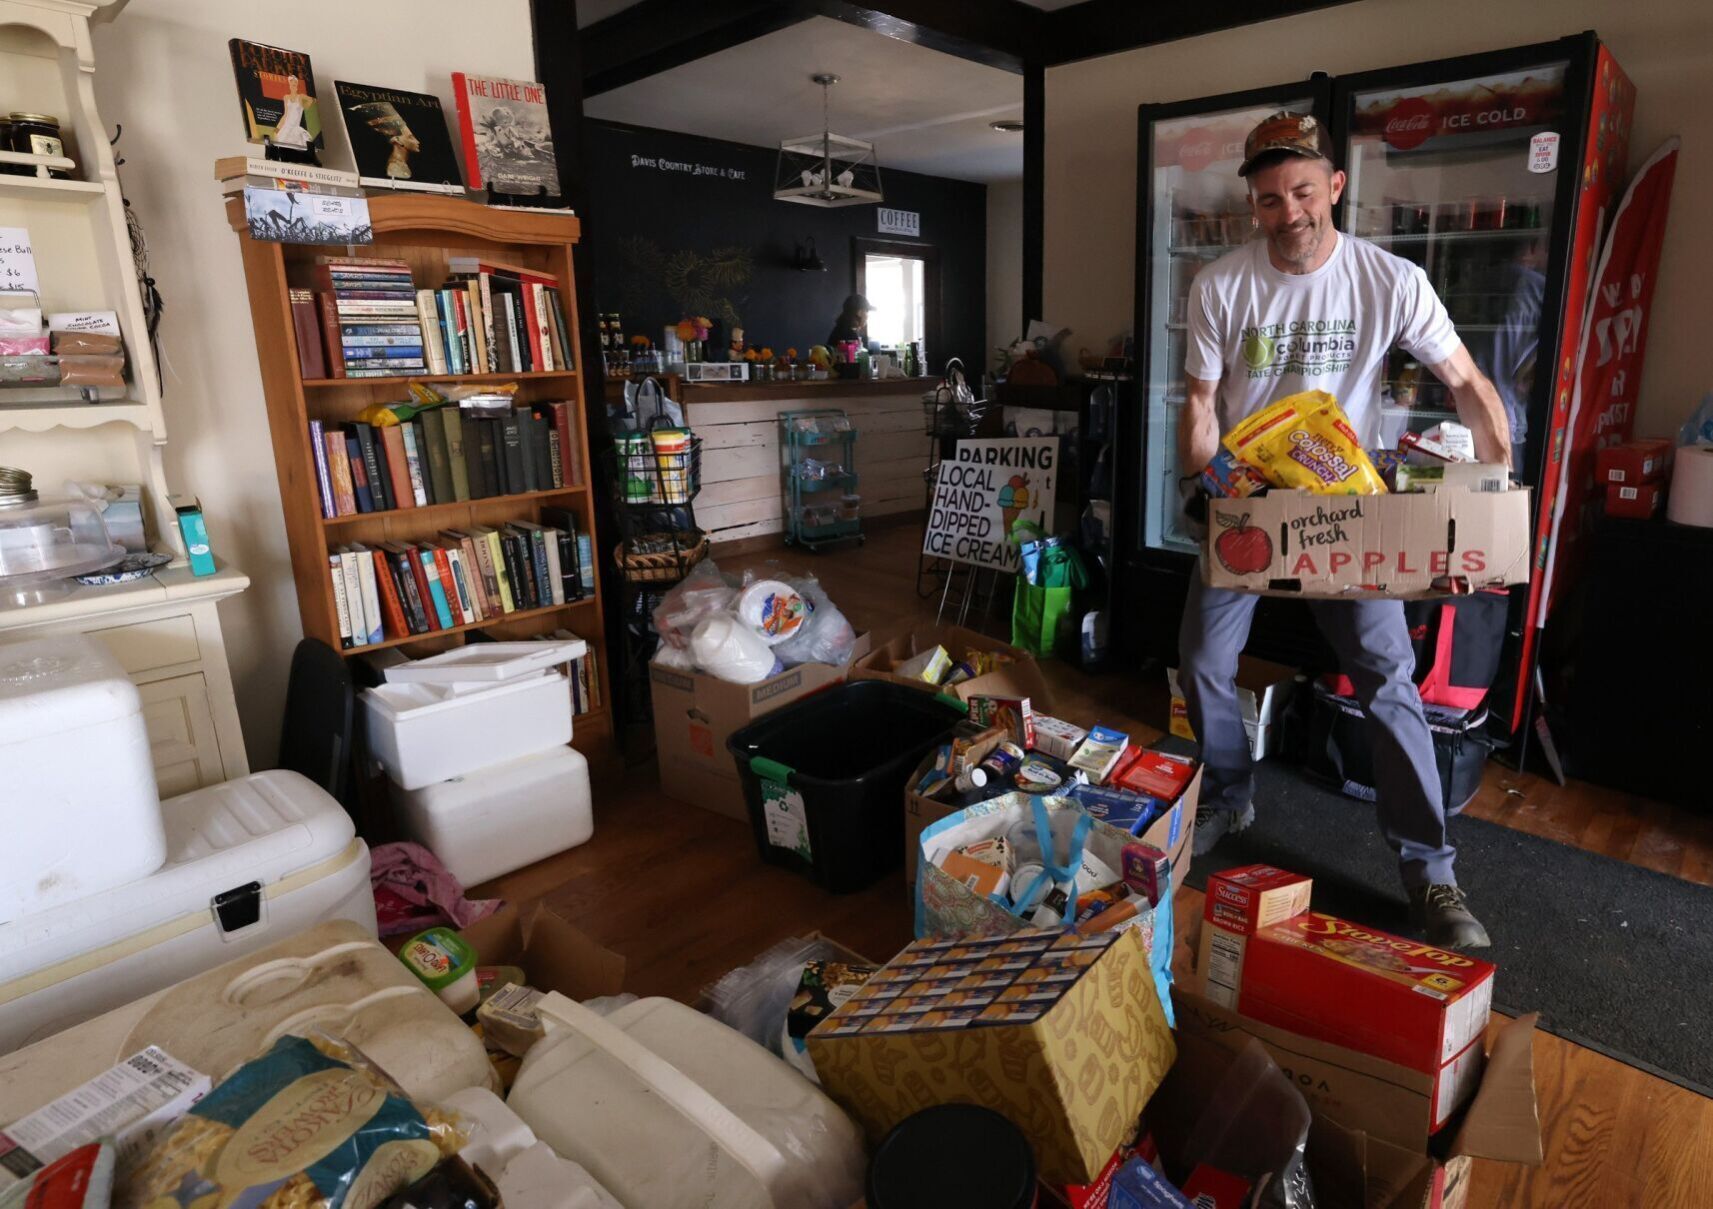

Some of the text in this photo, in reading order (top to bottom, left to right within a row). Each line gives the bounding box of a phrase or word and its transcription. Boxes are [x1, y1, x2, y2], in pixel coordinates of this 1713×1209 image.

[339, 85, 440, 109] Egyptian Art
[468, 78, 545, 105] THE LITTLE ONE
[1443, 107, 1526, 129] ICE COLD
[1221, 142, 1243, 155] ICE
[880, 209, 918, 229] COFFEE
[1241, 319, 1356, 338] NORTH CAROLINA
[1276, 336, 1354, 355] columbia
[1288, 430, 1359, 482] Colossal
[939, 464, 996, 492] LOCAL
[935, 487, 991, 513] HAND-
[931, 509, 991, 538] DIPPED
[1291, 500, 1364, 529] orchard
[1299, 523, 1349, 550] fresh
[926, 531, 1020, 569] ICE CREAM
[1292, 550, 1487, 575] APPLES
[757, 672, 798, 699] MEDIUM
[1435, 976, 1447, 985] 6
[260, 1087, 375, 1164] DAKOTA
